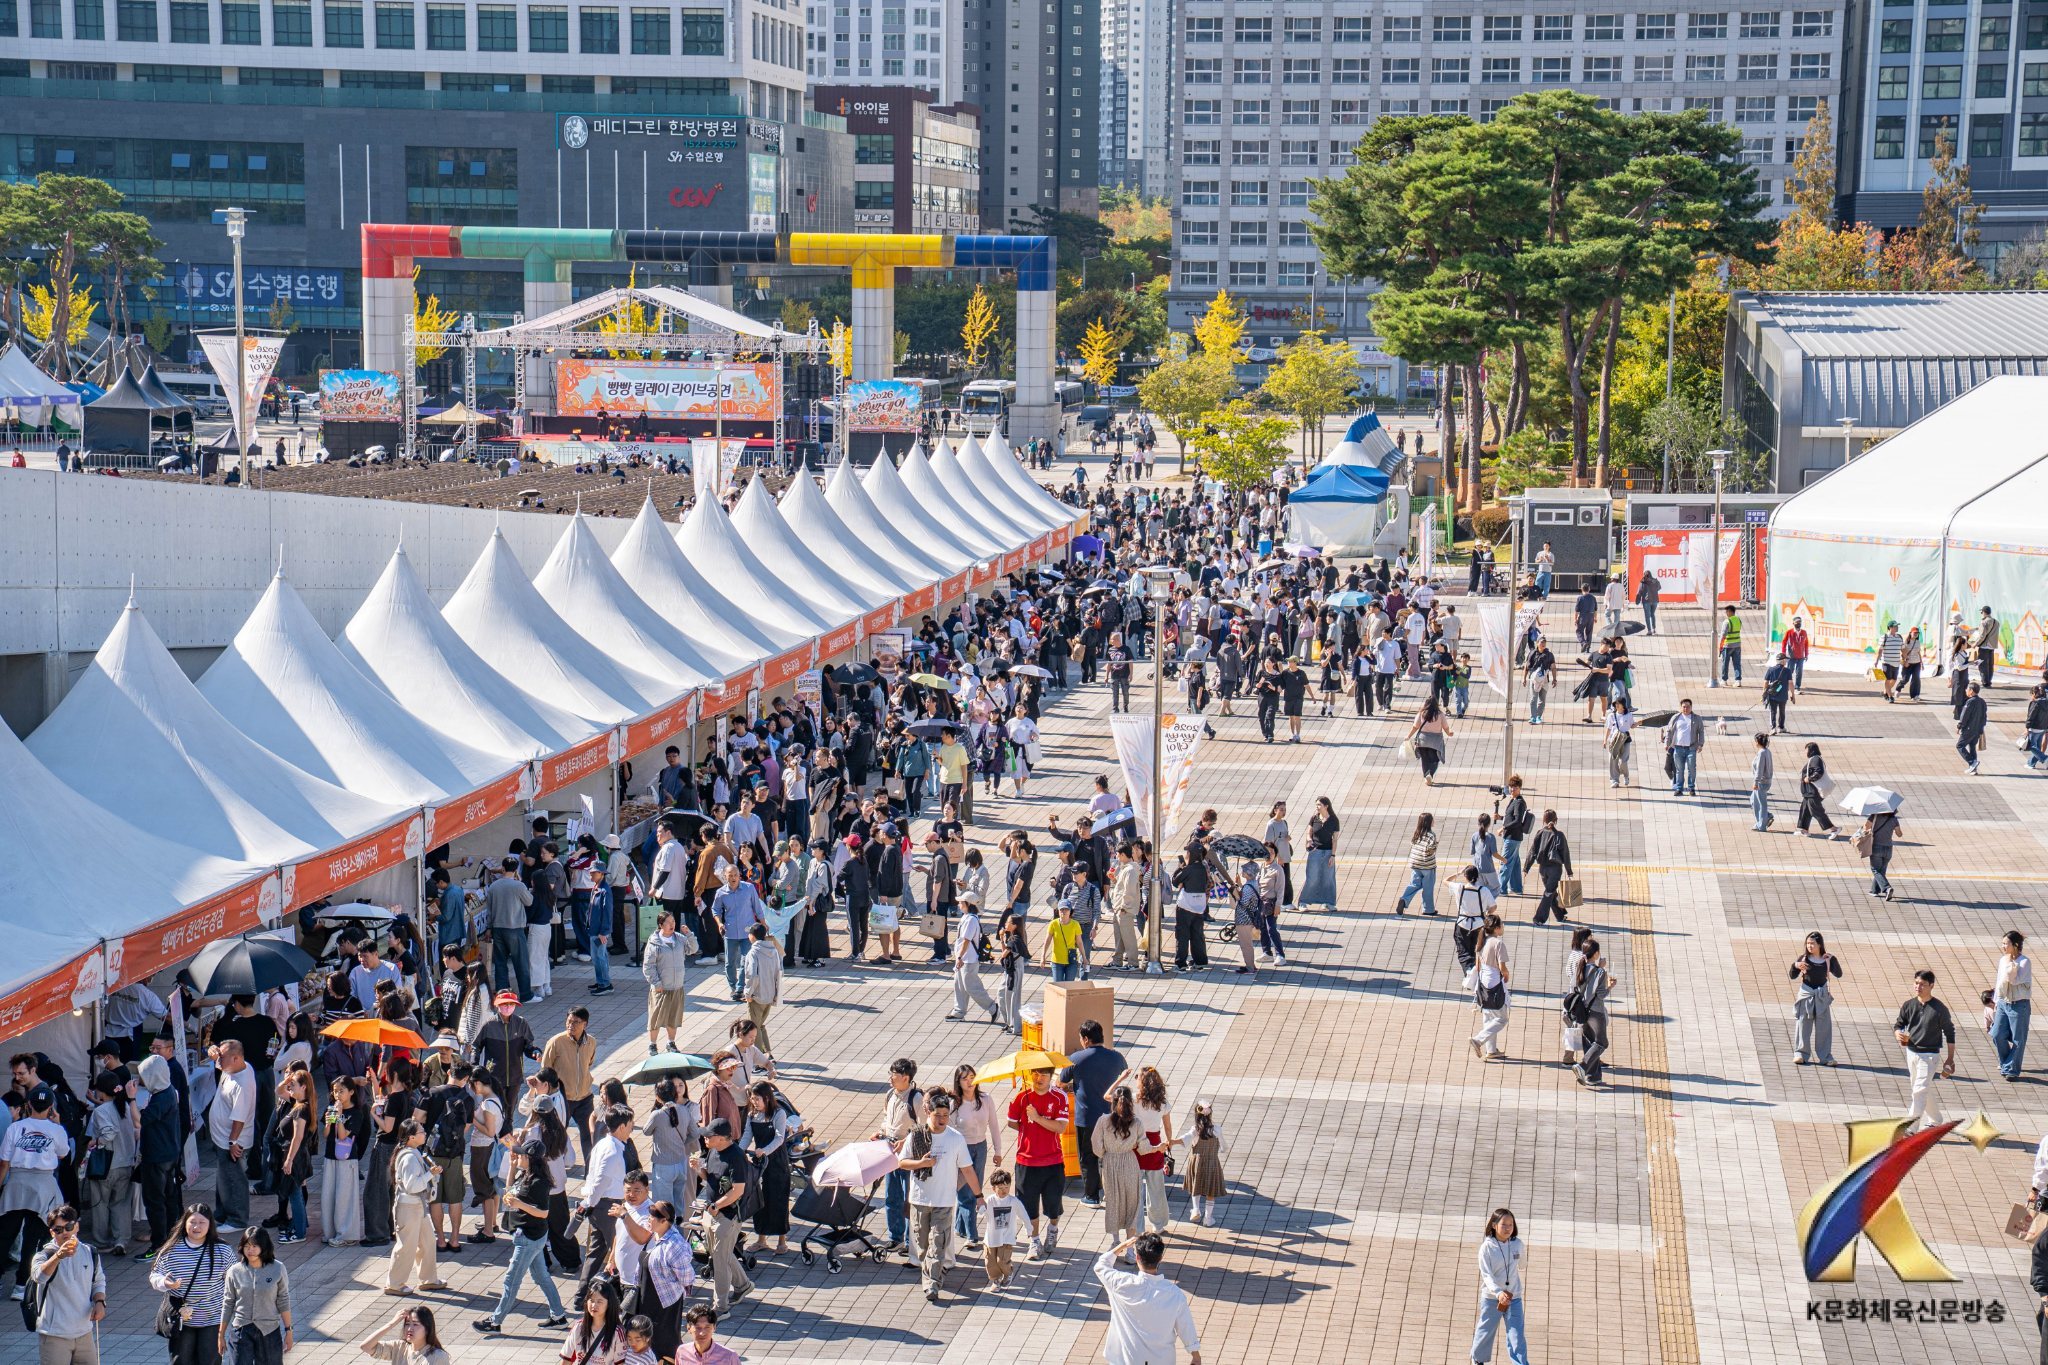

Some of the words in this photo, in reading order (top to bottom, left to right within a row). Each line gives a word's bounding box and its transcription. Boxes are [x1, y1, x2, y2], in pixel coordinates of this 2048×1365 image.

[853, 102, 889, 115] 아이본
[593, 119, 661, 136] 메디그린
[669, 120, 737, 137] 한방병원
[684, 140, 736, 149] 1522-2357
[667, 151, 683, 163] Sh
[685, 151, 724, 163] 수협은행
[669, 187, 718, 208] CGV
[248, 273, 337, 300] 수협은행
[347, 379, 371, 390] 2026
[607, 381, 632, 396] 빵빵
[634, 382, 669, 397] 릴레이
[870, 390, 894, 401] 2026
[615, 444, 640, 453] 2026
[1657, 568, 1677, 578] 여자
[284, 880, 294, 896] 43
[109, 949, 121, 971] 42
[15, 1138, 54, 1148] HOCKEY
